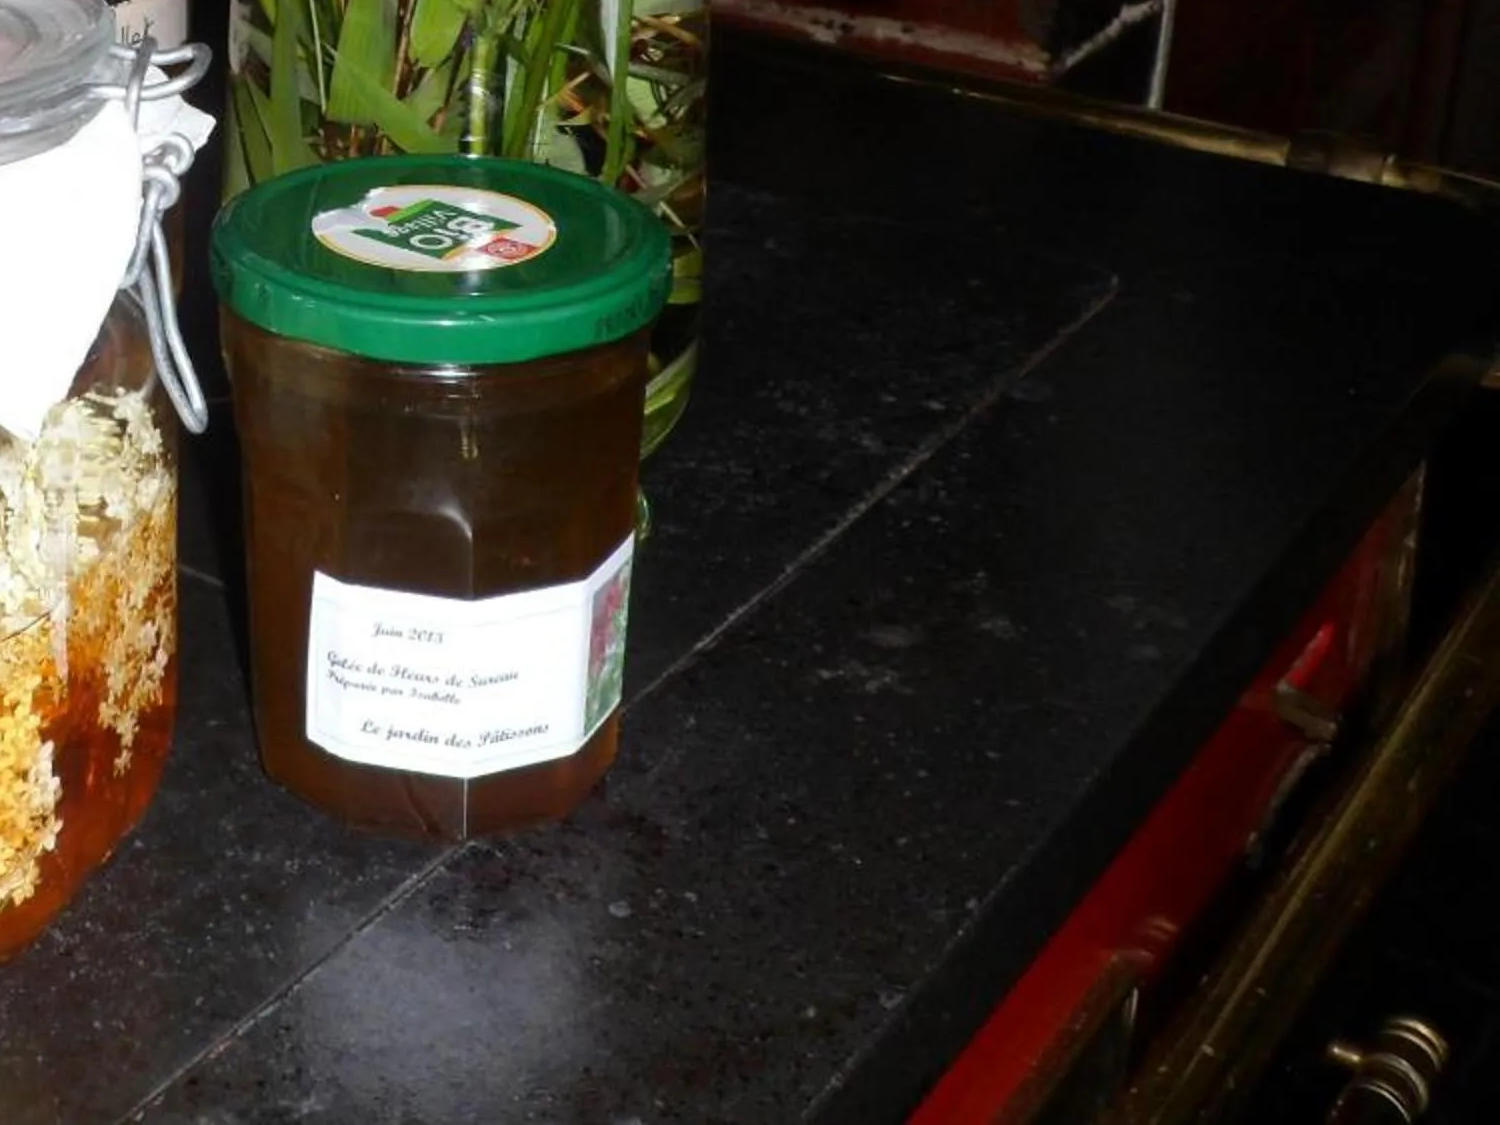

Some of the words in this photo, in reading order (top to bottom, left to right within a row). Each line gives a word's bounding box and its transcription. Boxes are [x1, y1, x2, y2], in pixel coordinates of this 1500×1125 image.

[370, 621, 403, 638] Juin
[366, 660, 385, 676] de
[389, 664, 439, 684] Fleurs
[444, 673, 463, 688] de
[380, 686, 404, 696] par
[360, 718, 380, 735] Le
[385, 725, 439, 745] jardin
[444, 733, 472, 749] des
[477, 722, 550, 748] Pâtissons
